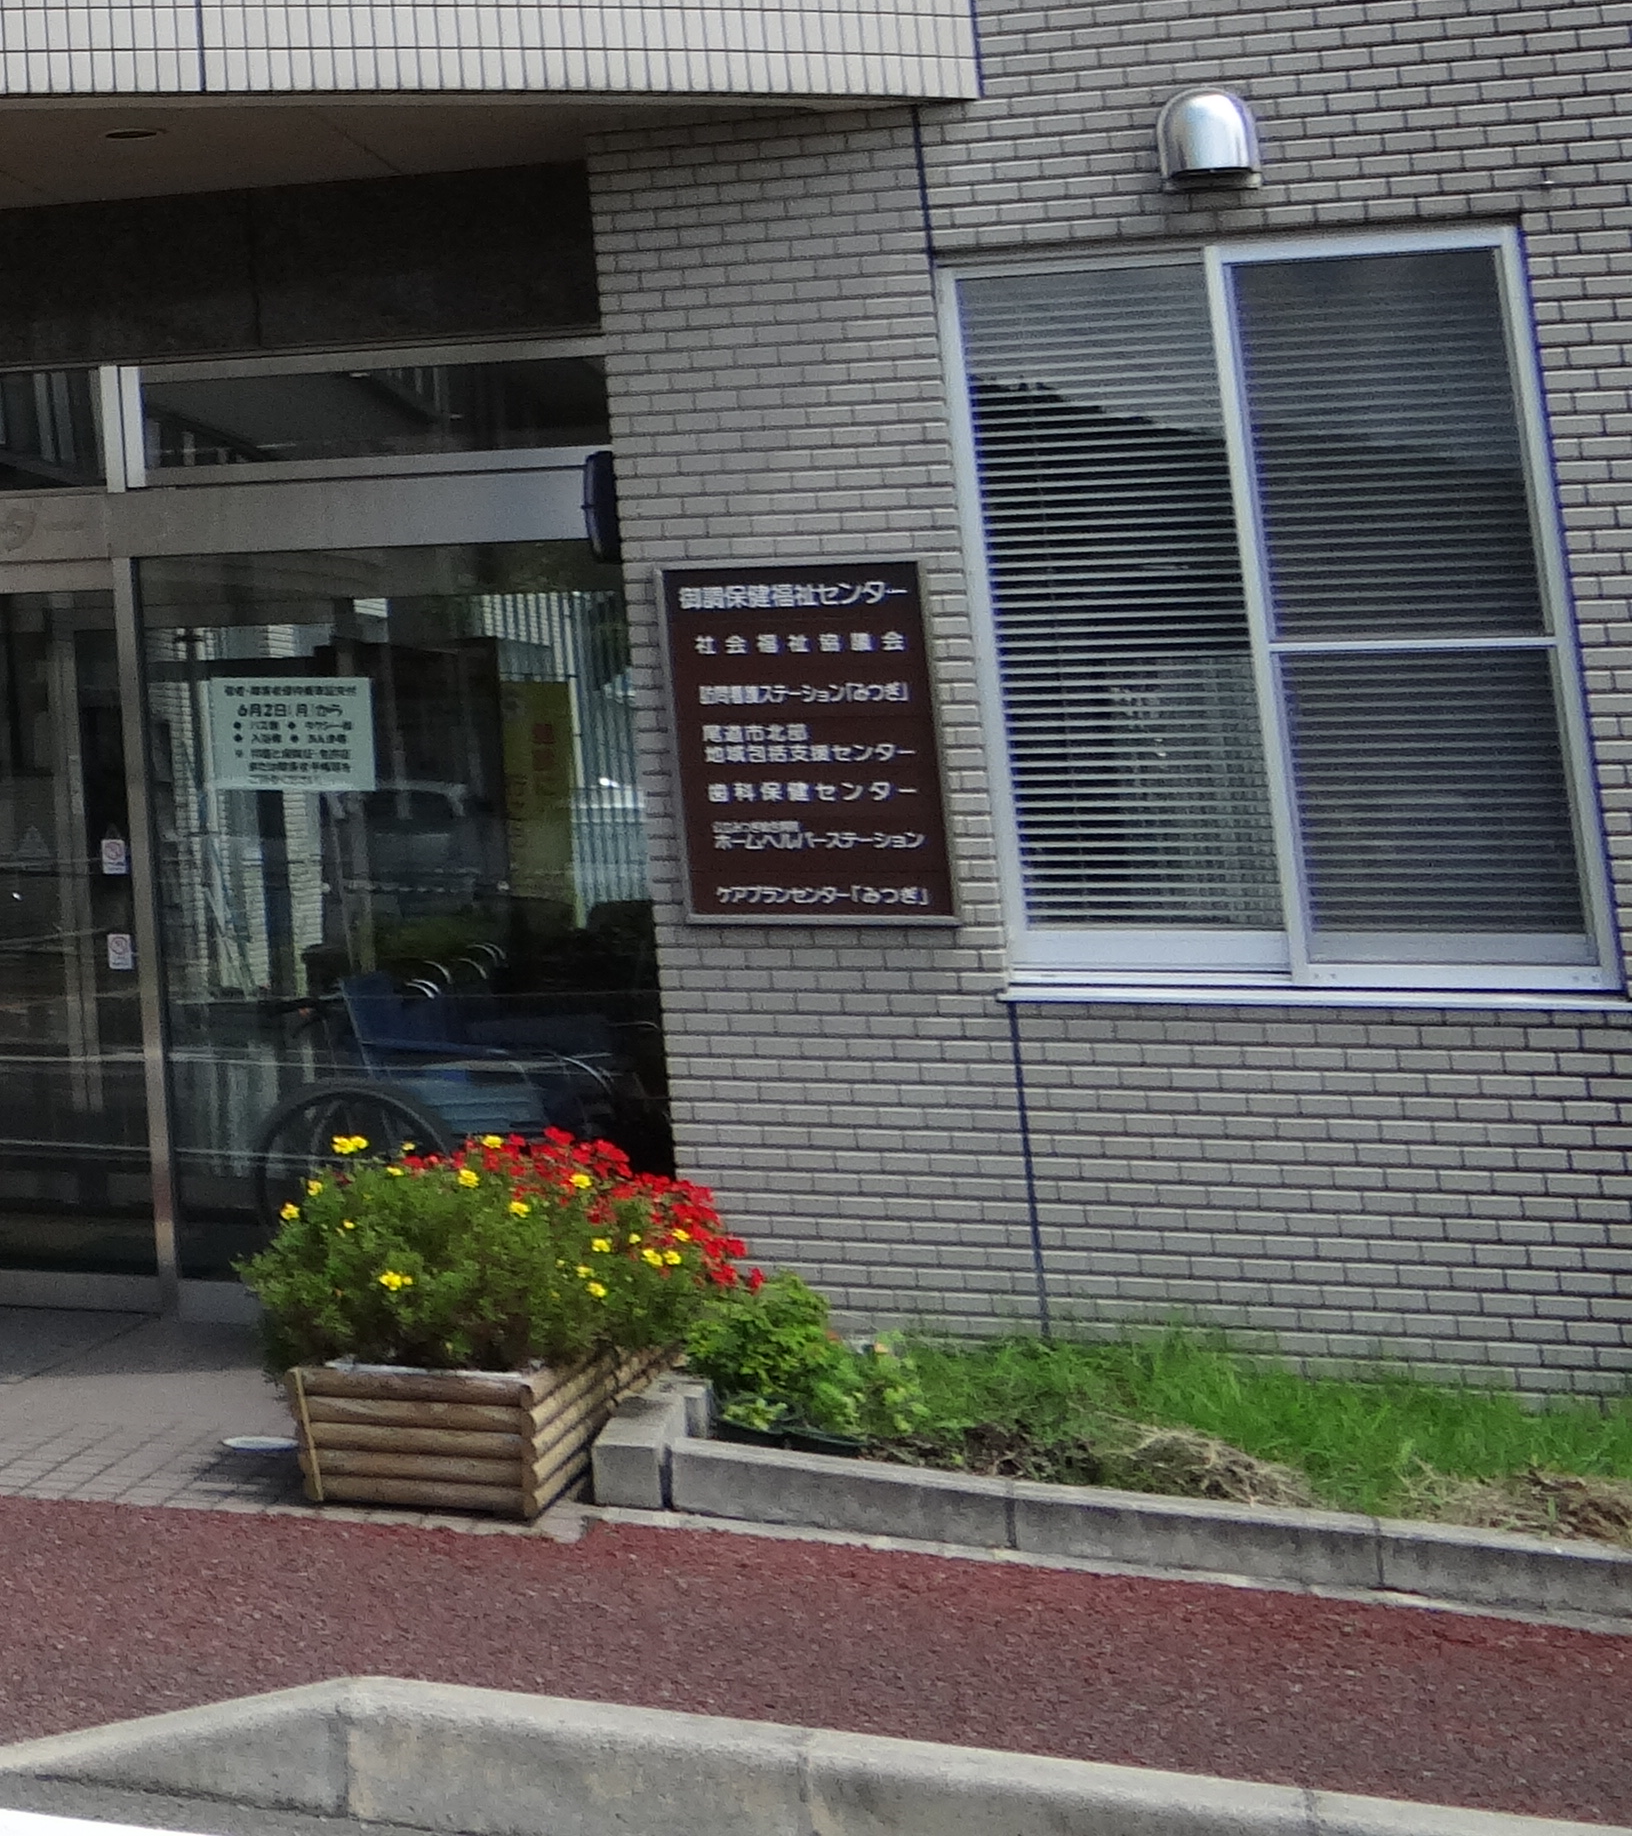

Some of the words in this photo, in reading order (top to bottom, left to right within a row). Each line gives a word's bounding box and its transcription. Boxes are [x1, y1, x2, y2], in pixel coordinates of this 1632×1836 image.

[678, 581, 909, 610] 御調保健福祉センター
[694, 631, 905, 655] 社会福祉協議会
[702, 723, 808, 743] 尾道市北部
[705, 744, 916, 763] 地域包括支援センター
[708, 782, 917, 802] 歯科保健センター
[714, 832, 925, 850] ホームヘルパーステーション
[716, 885, 930, 905] ケアプランセンター「みつぎ」
